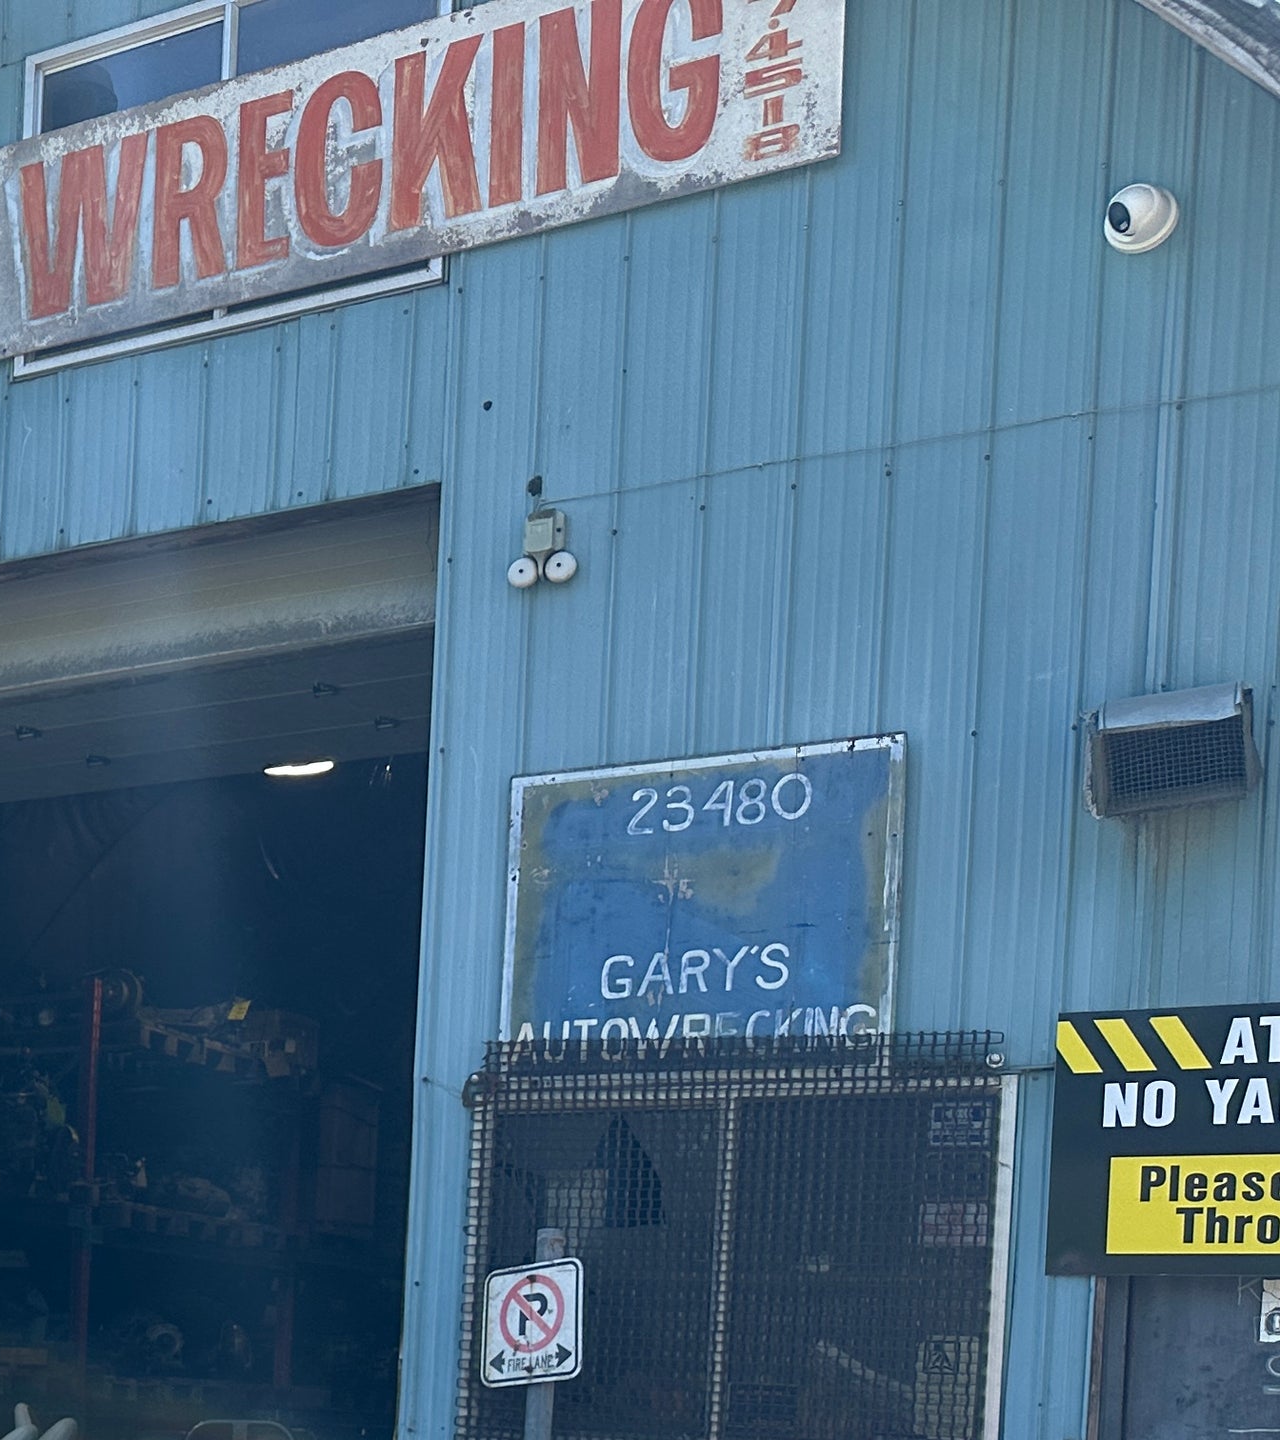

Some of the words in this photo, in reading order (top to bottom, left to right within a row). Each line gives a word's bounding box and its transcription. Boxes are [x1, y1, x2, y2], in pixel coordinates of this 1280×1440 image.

[18, 0, 724, 319] WRECKING
[627, 772, 813, 836] 23480
[600, 942, 791, 999] GARY'S
[510, 1003, 878, 1066] AUTOWRECKING
[1102, 1080, 1176, 1128] NO
[1205, 1077, 1275, 1125] YA
[1175, 1206, 1280, 1245] Thro
[507, 1357, 526, 1372] FIRE
[529, 1353, 555, 1370] LANE
